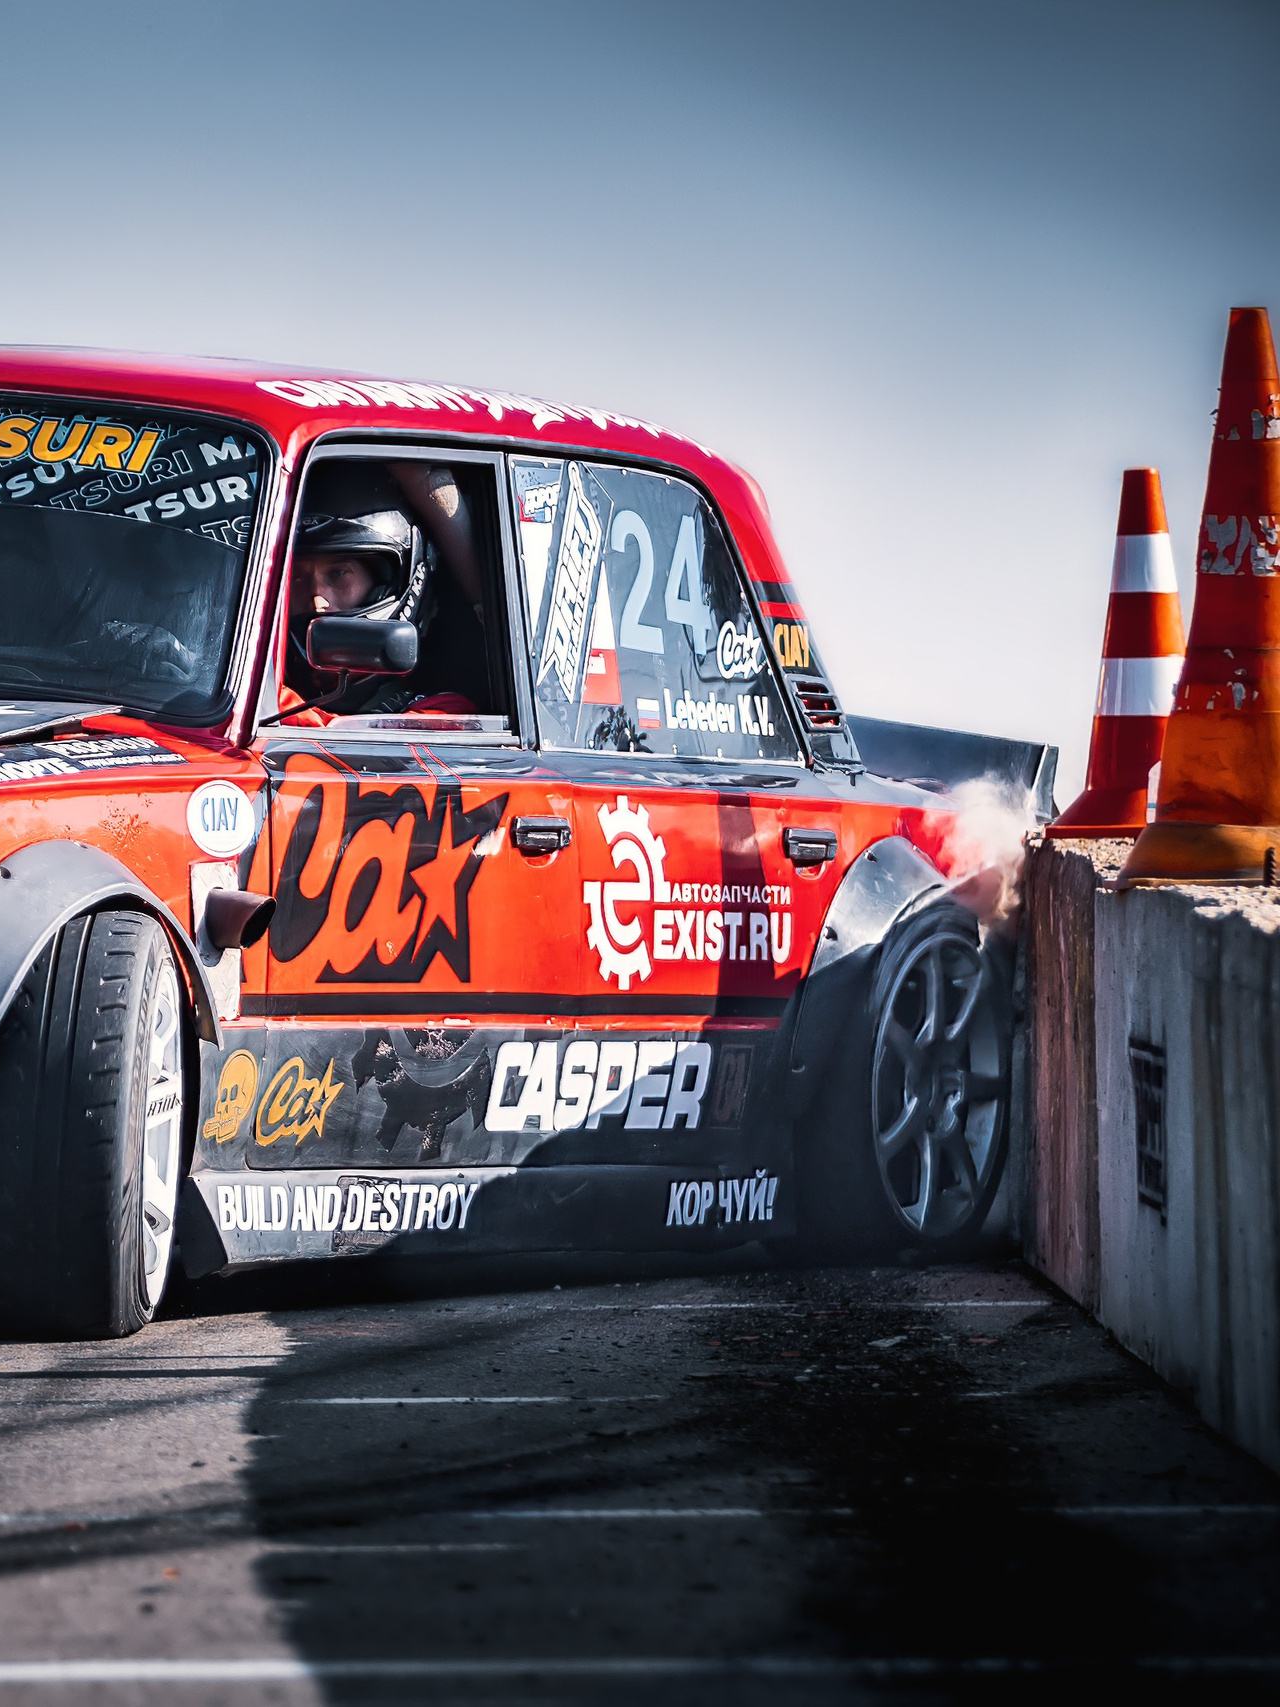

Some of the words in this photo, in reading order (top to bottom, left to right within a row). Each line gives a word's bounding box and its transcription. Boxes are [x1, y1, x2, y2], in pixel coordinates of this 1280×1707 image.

[610, 510, 712, 656] 24
[662, 687, 736, 735] Lebedev
[737, 694, 775, 737] K.V.
[671, 883, 792, 906] АВТОЗАПЧАСТИ
[653, 909, 792, 965] EXIST.RU
[485, 1040, 711, 1132] CASPER
[216, 1184, 287, 1233] BUILD
[291, 1185, 342, 1232] AND
[342, 1182, 478, 1232] DESTROY
